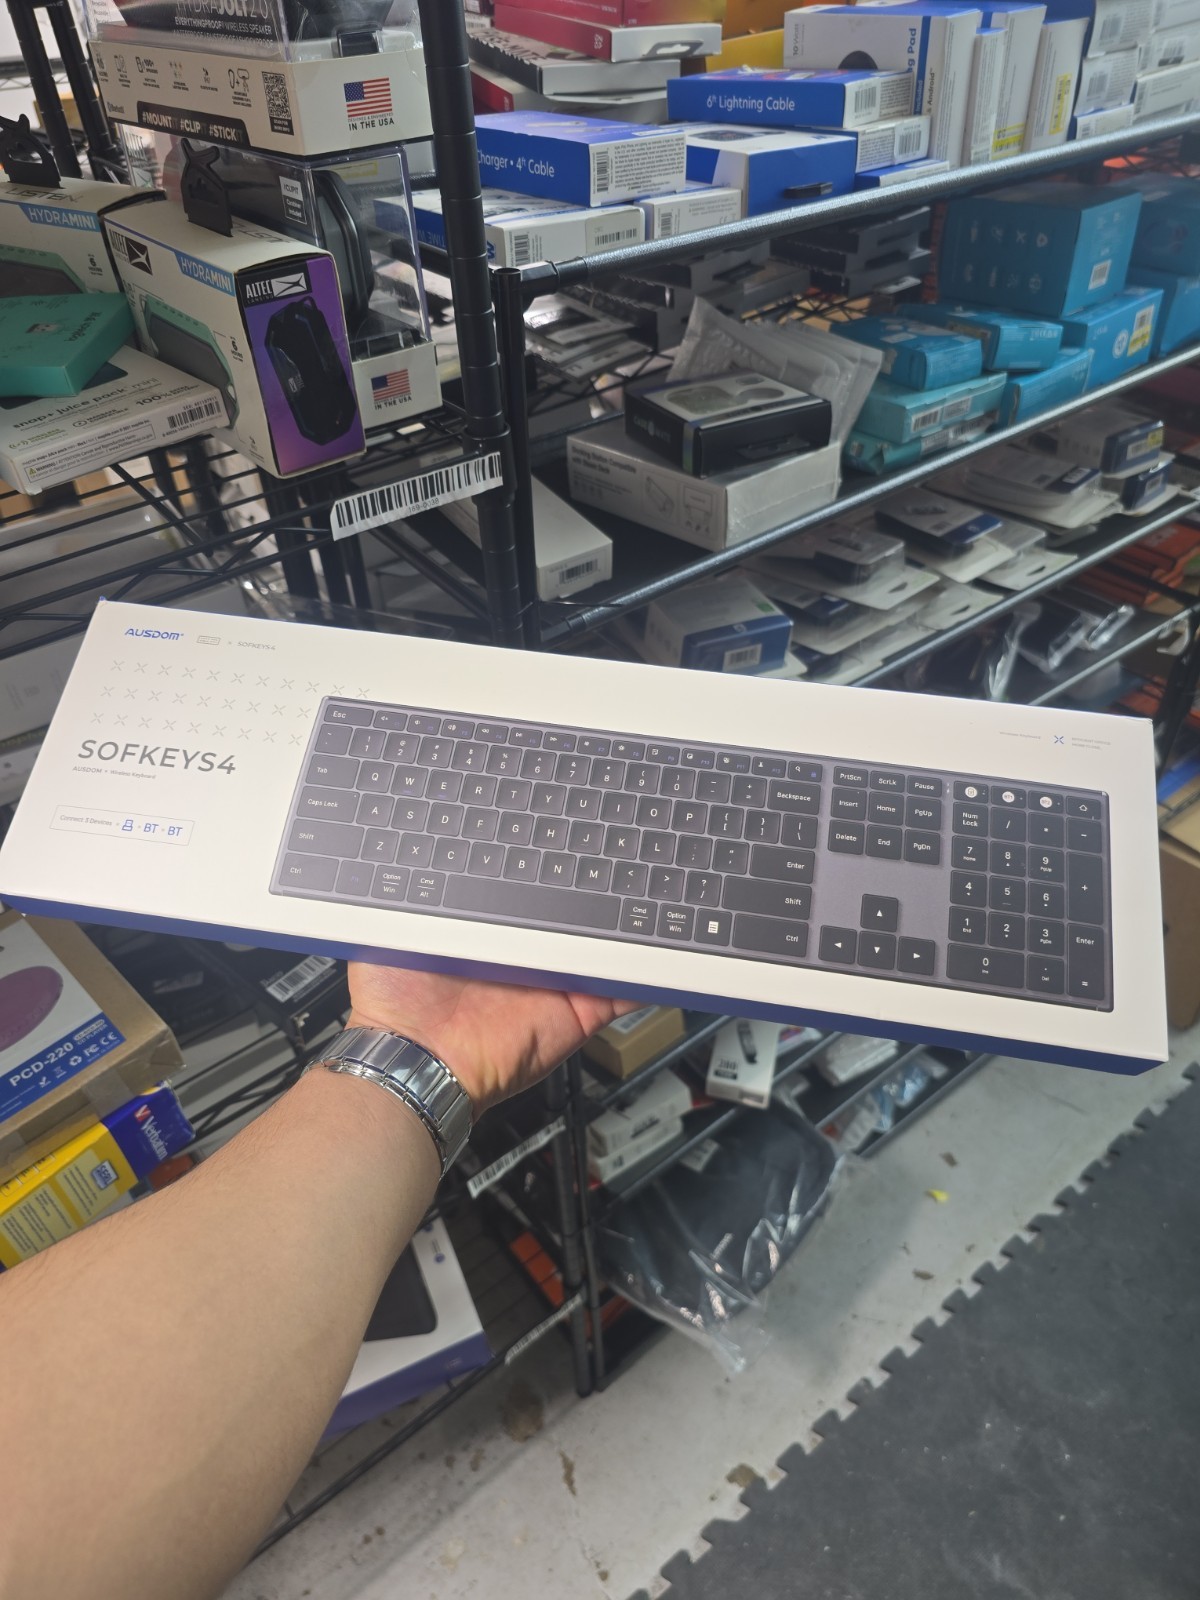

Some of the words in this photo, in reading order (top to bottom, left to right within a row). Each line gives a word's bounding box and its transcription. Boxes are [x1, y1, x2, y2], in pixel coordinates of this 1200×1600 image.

[907, 28, 917, 53] Pad
[719, 96, 763, 112] Lightning
[766, 97, 795, 111] Cable
[349, 122, 357, 131] IN
[360, 120, 375, 129] THE
[379, 118, 394, 126] USA
[528, 159, 555, 177] Cable
[28, 207, 97, 229] HYDRAMINI
[180, 257, 231, 293] HYDRAMINI
[246, 279, 272, 299] ALTEC
[384, 399, 397, 408] THE
[398, 395, 412, 404] USA
[12, 412, 55, 429] snap+
[56, 401, 90, 416] juice
[93, 387, 125, 404] pack
[125, 628, 180, 640] AUSDOM
[333, 710, 346, 718] Esc
[78, 739, 236, 775] SOFKEYS4
[72, 766, 103, 774] AUSDOM
[535, 766, 541, 774] 6
[371, 772, 379, 781] Q
[405, 777, 415, 785] W
[840, 773, 862, 781] PrtScn
[441, 782, 447, 790] E
[475, 786, 482, 794] R
[915, 782, 934, 790] Pause
[511, 790, 517, 799] T
[546, 795, 552, 803] Y
[777, 792, 811, 801] Backspace
[307, 798, 323, 806] Caps
[580, 799, 587, 808] U
[371, 806, 378, 814] A
[915, 809, 933, 817] PgUp
[407, 811, 414, 819] S
[441, 815, 449, 824] D
[686, 813, 693, 821] P
[60, 814, 84, 824] Connect
[89, 818, 113, 827] Devices
[143, 822, 159, 834] BT
[167, 825, 183, 837] BT
[477, 819, 483, 828] F
[962, 819, 978, 827] Lock
[512, 824, 519, 833] G
[547, 829, 555, 838] H
[583, 834, 590, 842] J
[835, 833, 857, 842] Delete
[376, 841, 384, 850] Z
[618, 838, 625, 847] K
[878, 838, 891, 846] End
[412, 846, 420, 855] X
[654, 843, 660, 852] L
[967, 846, 973, 854] 7
[447, 851, 455, 860] C
[484, 855, 490, 864] V
[1005, 851, 1011, 860] 8
[518, 860, 525, 869] B
[1042, 857, 1049, 865] 9
[554, 865, 562, 874] N
[589, 870, 598, 878] M
[965, 882, 972, 890] 4
[1004, 887, 1011, 896] 5
[1043, 893, 1049, 901] 6
[667, 911, 686, 919] Option
[1004, 924, 1010, 932] 2
[1042, 928, 1049, 937] 3
[1076, 937, 1094, 945] Enter
[8, 1040, 75, 1087] PCD-220
[140, 1114, 169, 1161] Verbatim
